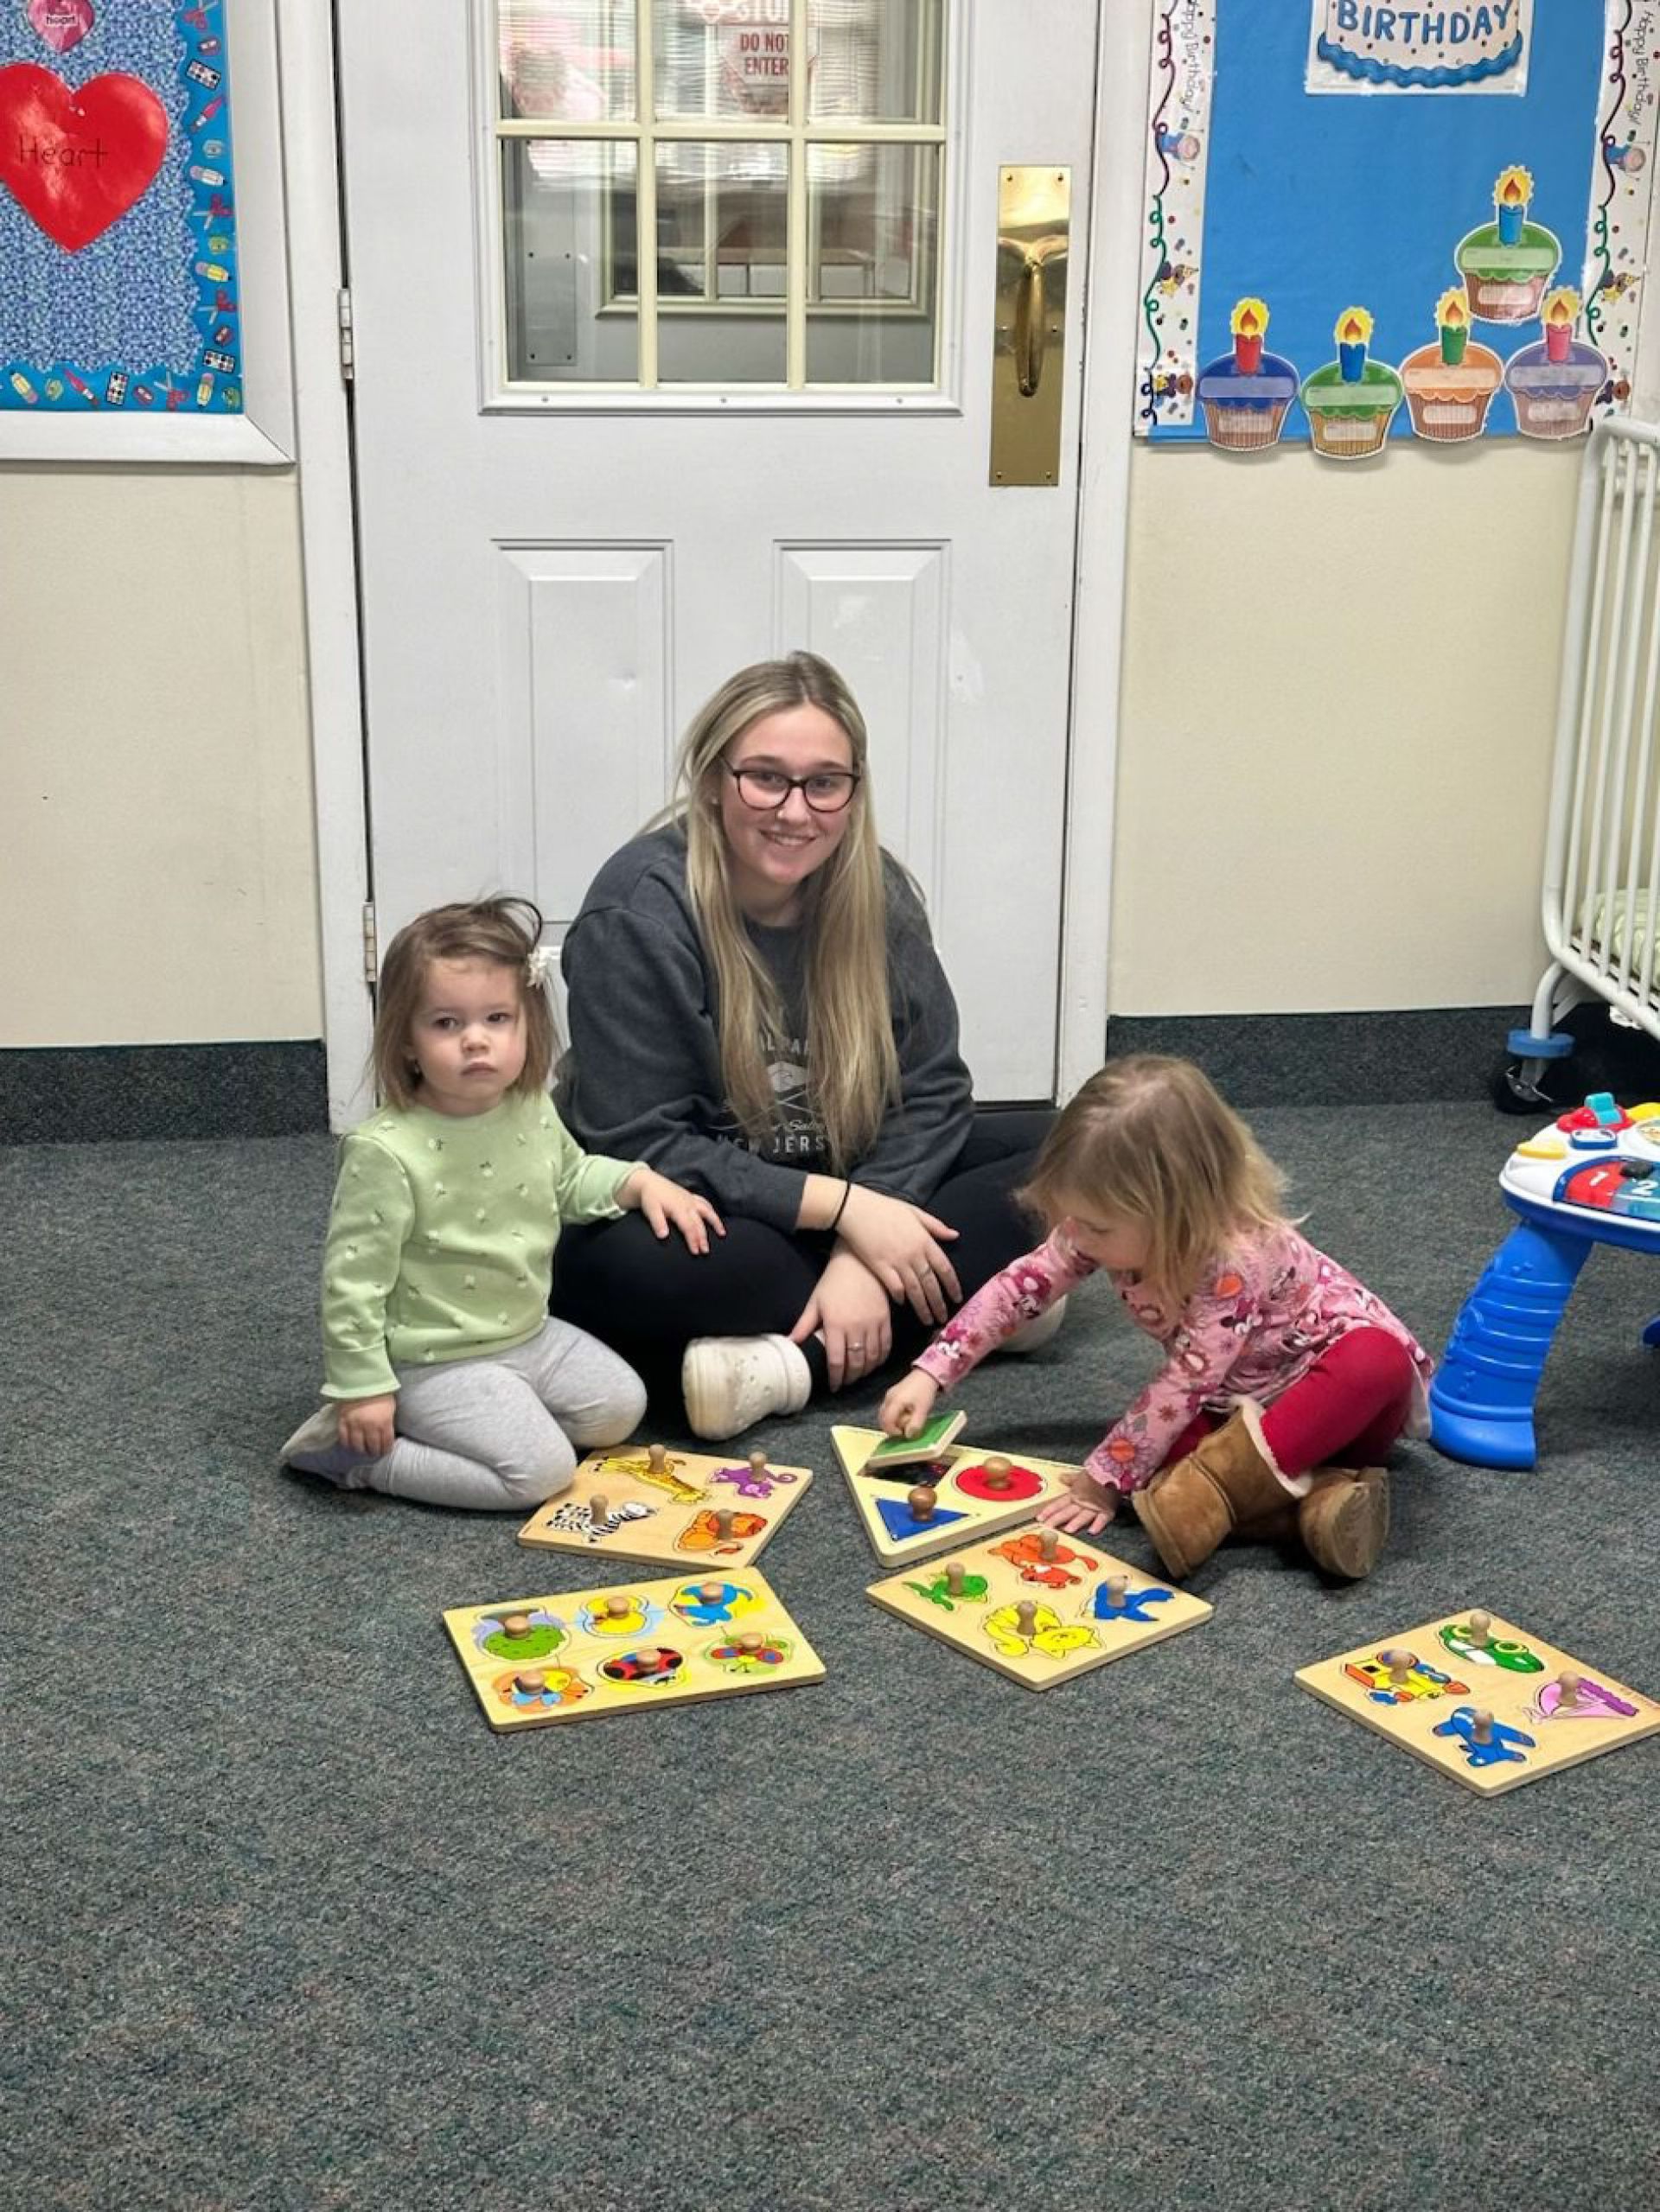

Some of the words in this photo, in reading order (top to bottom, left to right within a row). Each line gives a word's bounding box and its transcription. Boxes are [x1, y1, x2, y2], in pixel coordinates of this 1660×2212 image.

[1338, 0, 1513, 43] BIRTHDAY
[1631, 10, 1654, 54] Happy
[740, 33, 759, 52] DO
[745, 57, 788, 74] ENTER
[18, 135, 109, 169] Heart
[1589, 1171, 1610, 1186] 1
[1631, 1179, 1658, 1196] 2
